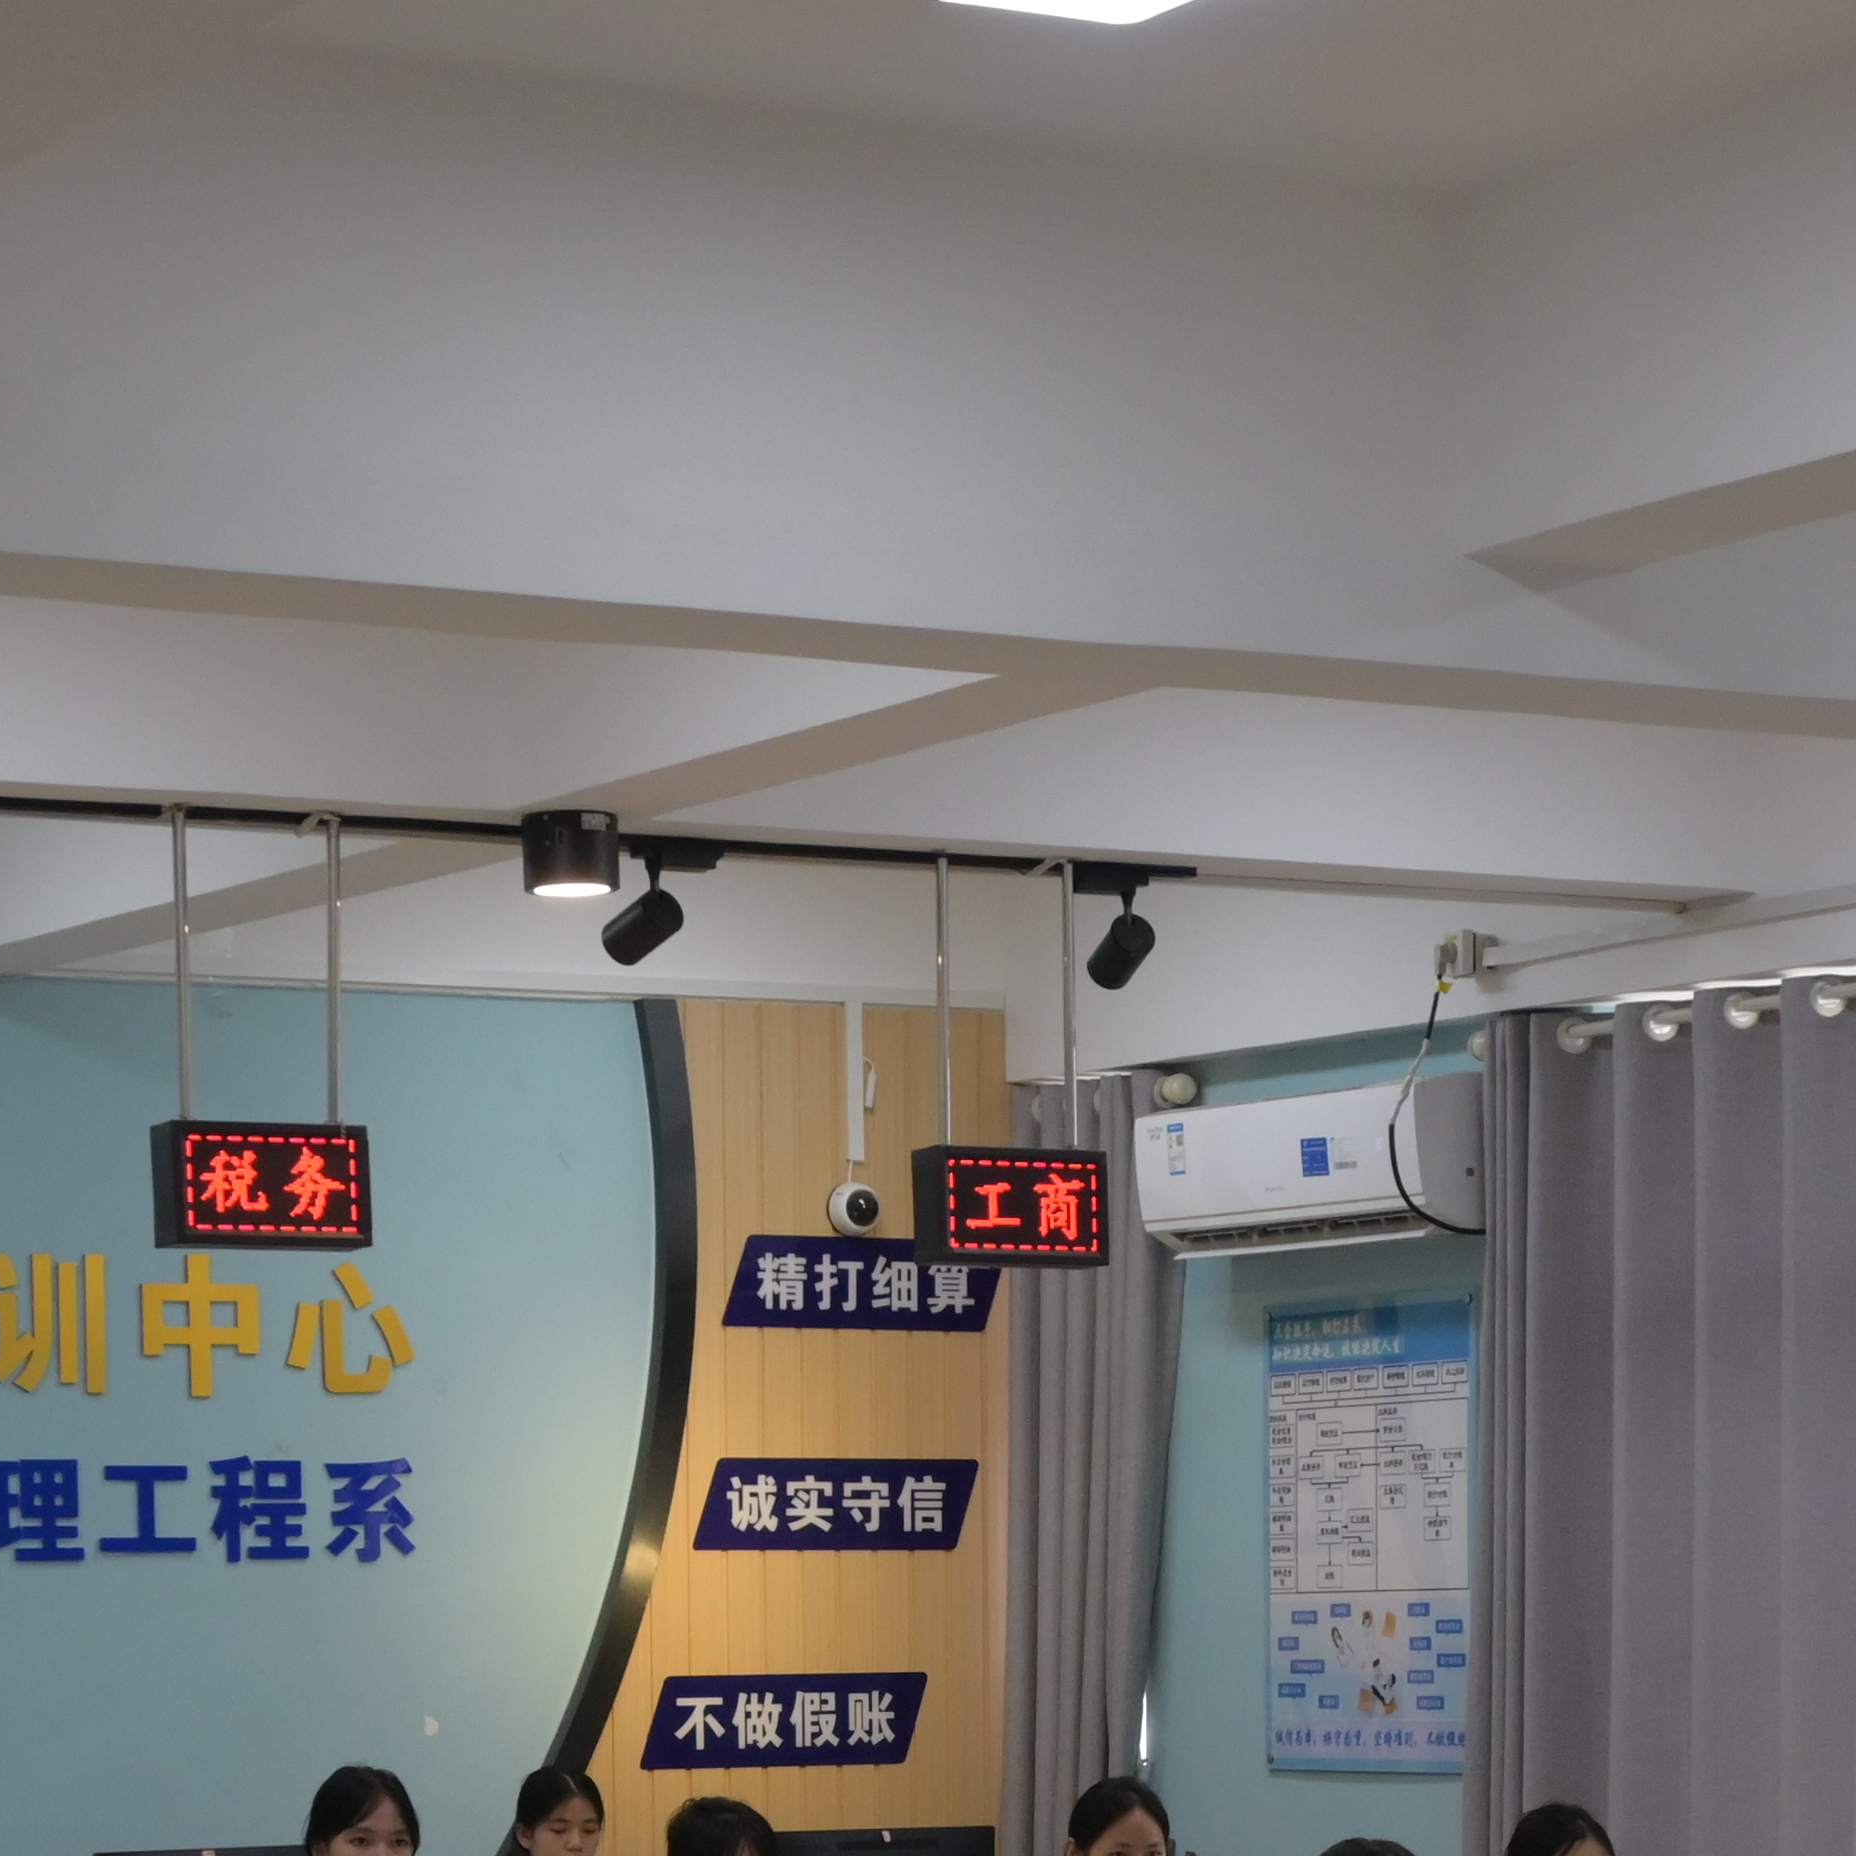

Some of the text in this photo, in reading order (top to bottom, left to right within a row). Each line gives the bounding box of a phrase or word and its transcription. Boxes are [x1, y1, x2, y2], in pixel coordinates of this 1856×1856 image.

[199, 1147, 346, 1221] 税务
[965, 1173, 1086, 1241] 工商
[756, 1252, 976, 1315] 精打细算
[726, 1474, 948, 1533] 诚实守信
[674, 1691, 897, 1750] 不做假账
